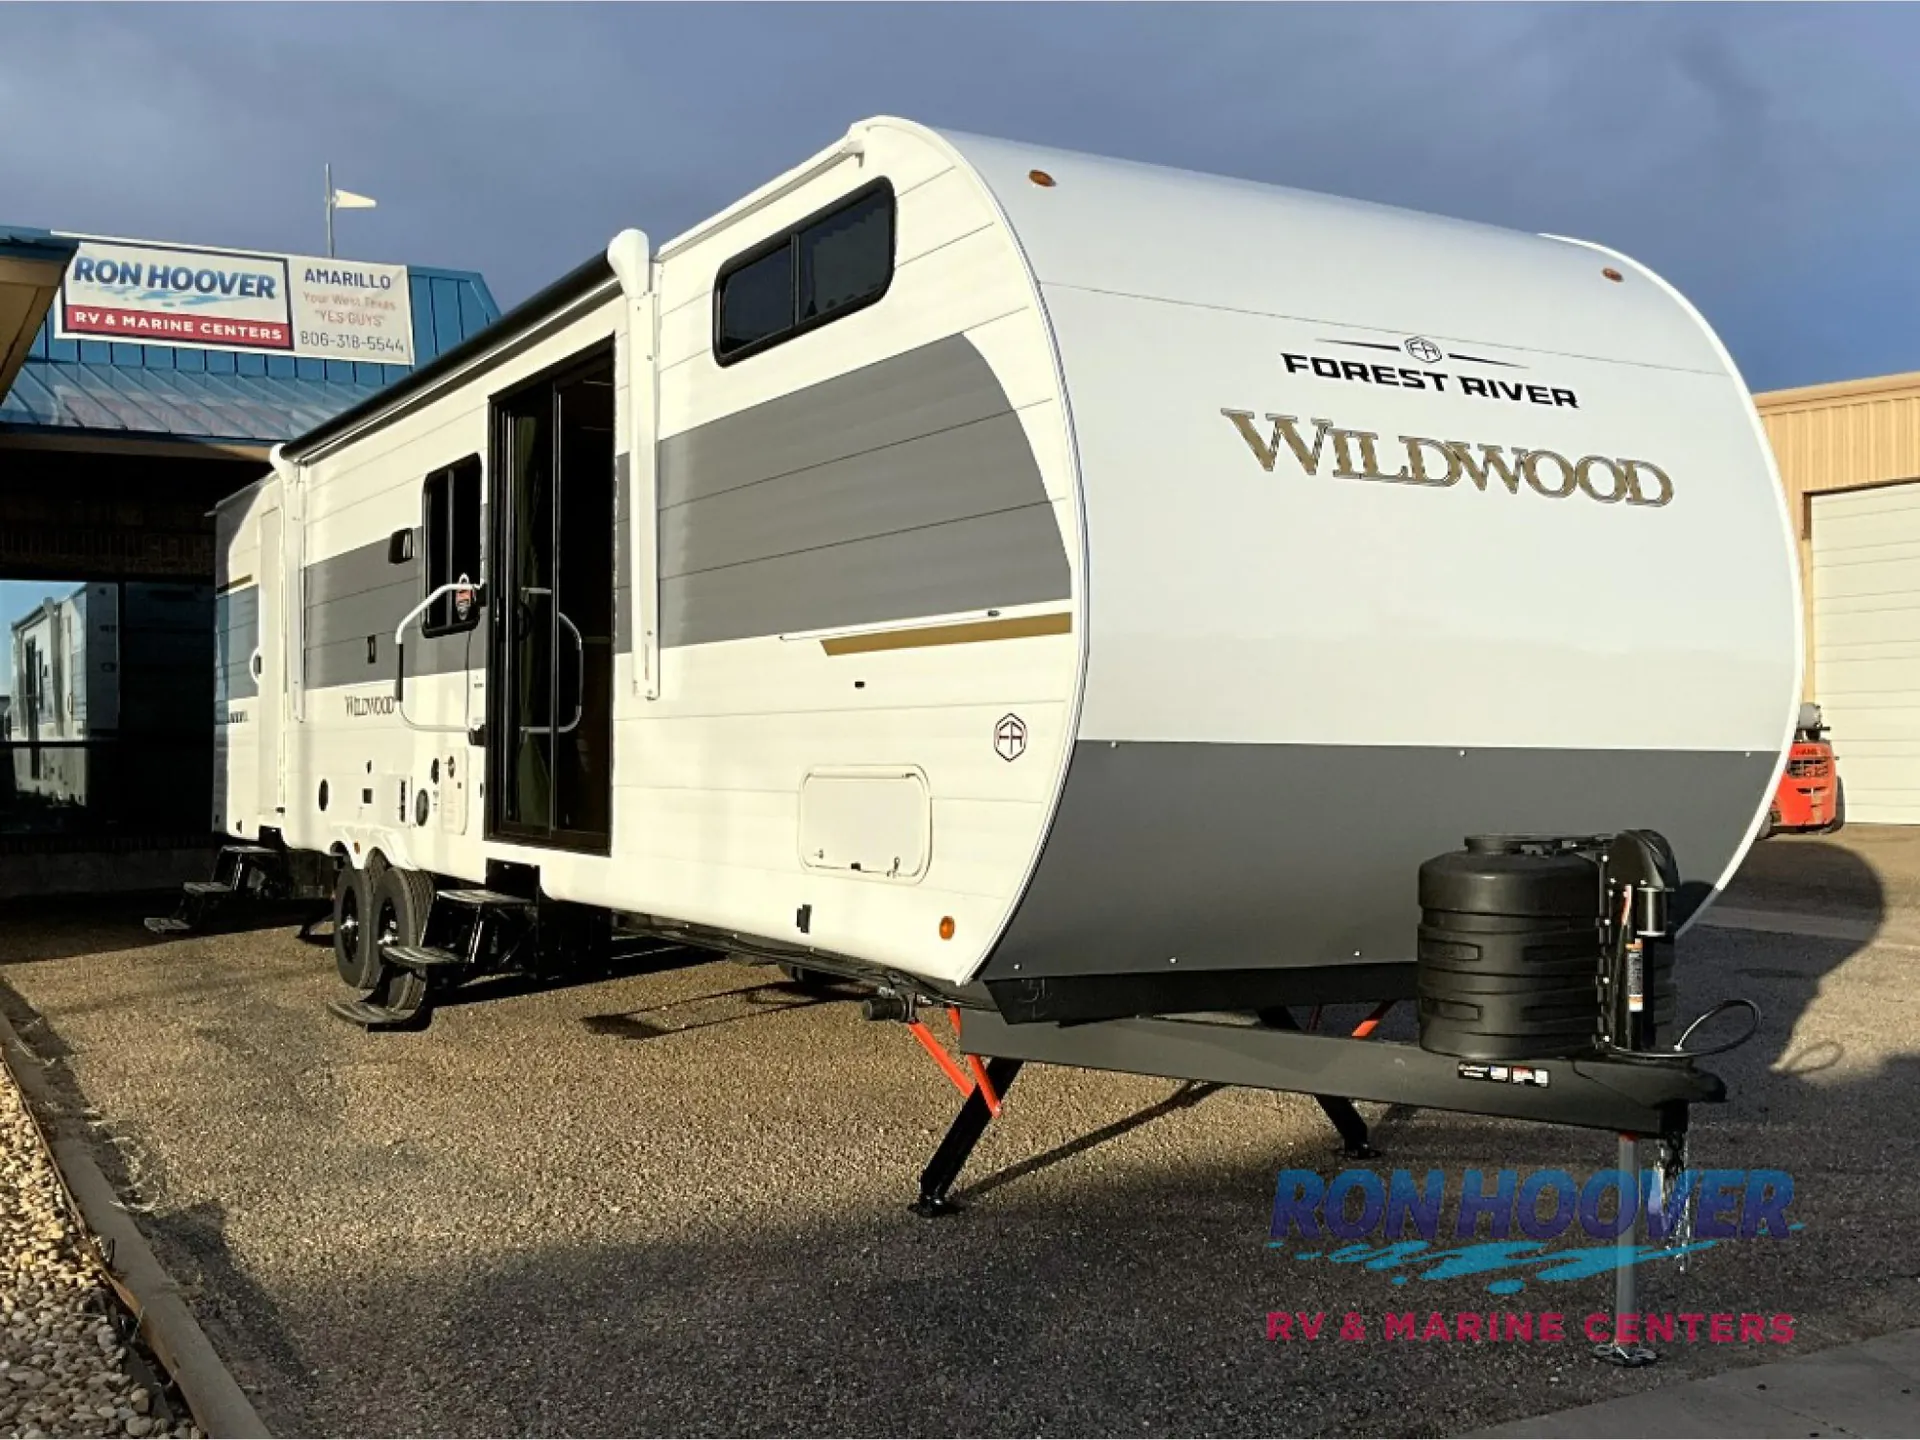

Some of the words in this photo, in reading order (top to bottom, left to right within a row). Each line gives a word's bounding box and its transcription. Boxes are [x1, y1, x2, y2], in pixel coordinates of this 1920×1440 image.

[73, 257, 142, 285] RON
[147, 264, 276, 299] HOOVER
[304, 268, 391, 290] AMARILLO
[74, 311, 100, 325] RV
[104, 313, 117, 325] &
[122, 315, 194, 333] MARINE
[200, 323, 283, 341] CENTERS
[300, 330, 404, 354] 806-318-5544
[1280, 352, 1449, 392] FOREST
[1457, 375, 1581, 409] RIVER
[1220, 407, 1675, 508] WILDWOOD
[344, 695, 395, 717] WILDWOOD
